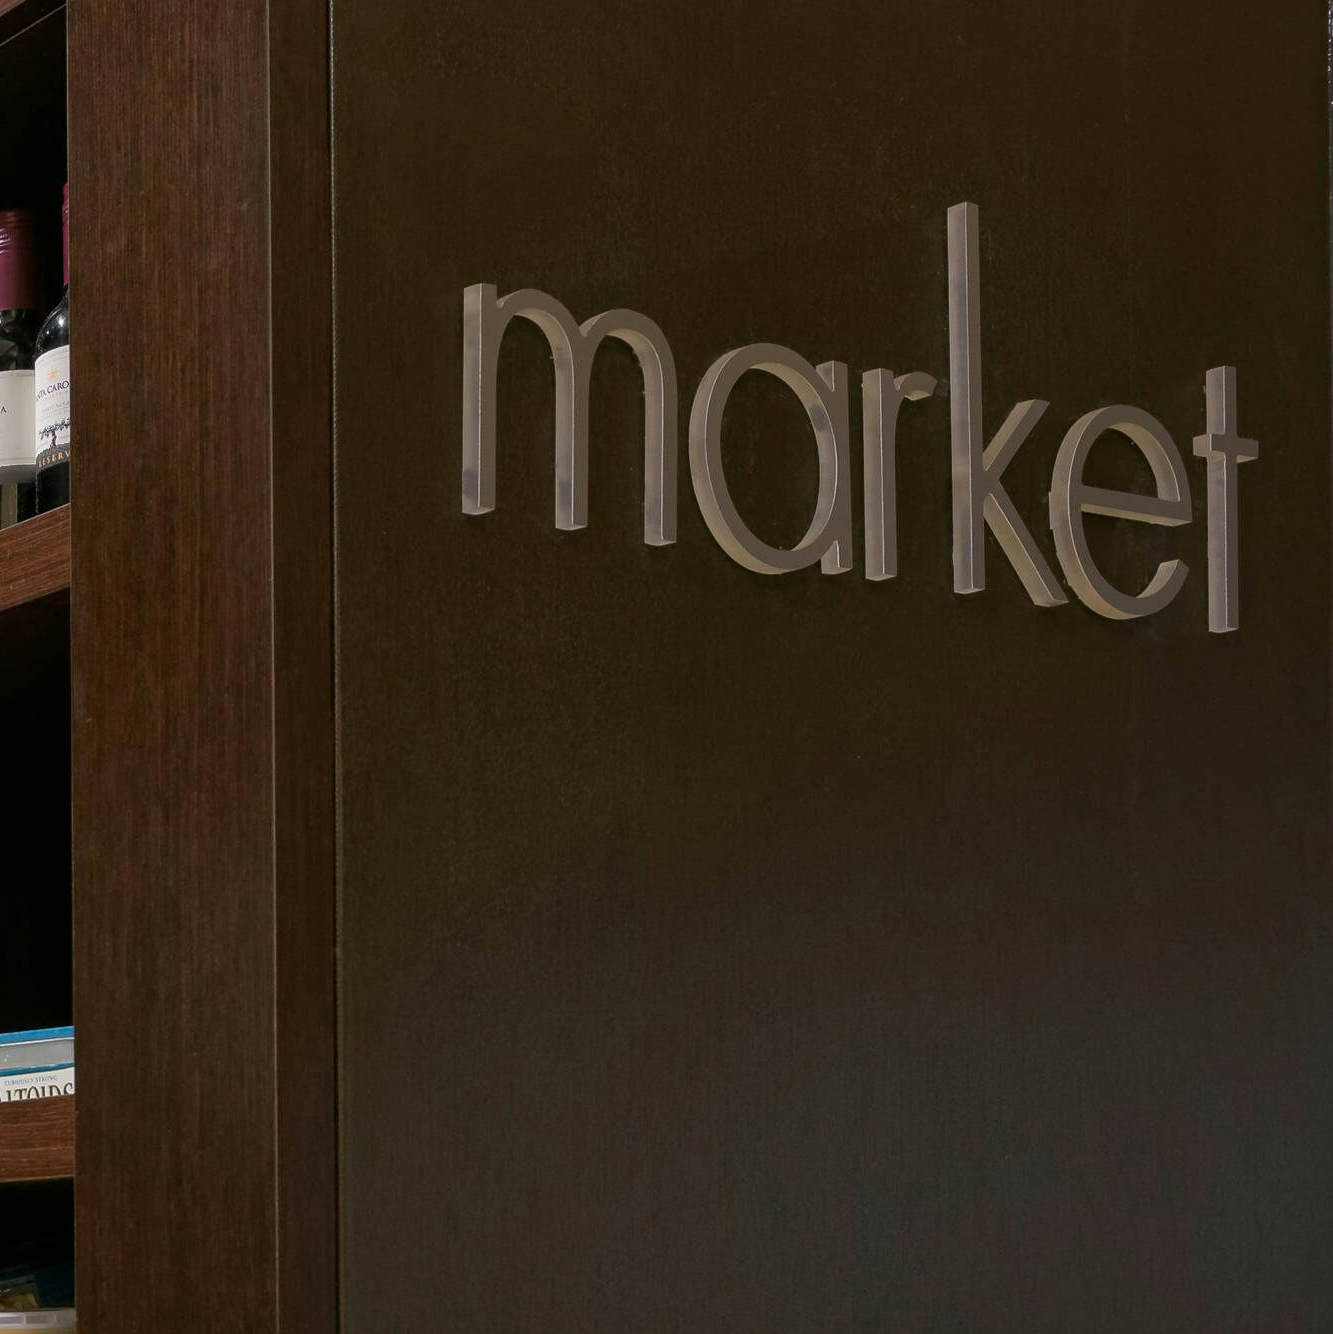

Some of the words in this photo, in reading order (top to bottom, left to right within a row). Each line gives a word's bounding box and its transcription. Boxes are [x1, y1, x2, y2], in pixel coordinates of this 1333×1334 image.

[47, 380, 70, 395] CARO
[462, 201, 1259, 635] market
[4, 1077, 34, 1086] CURIOUSLY
[35, 1075, 58, 1084] STRONG
